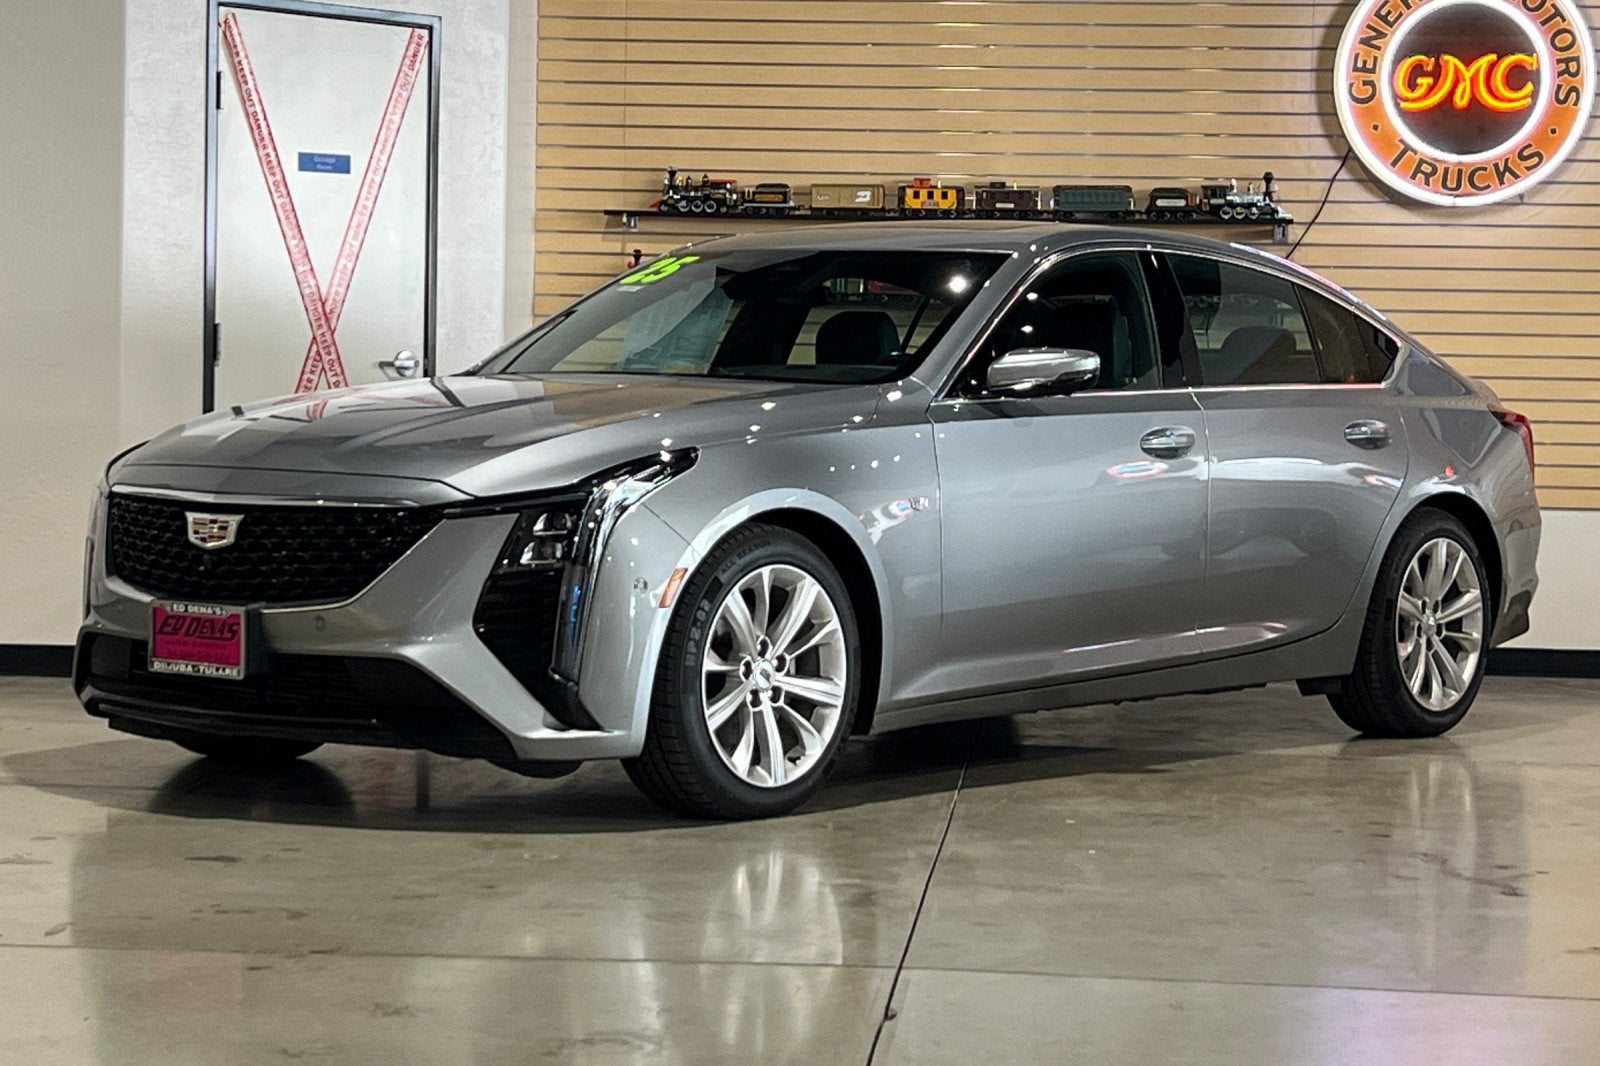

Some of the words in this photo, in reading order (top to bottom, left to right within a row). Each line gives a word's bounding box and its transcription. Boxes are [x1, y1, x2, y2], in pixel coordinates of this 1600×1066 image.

[1393, 53, 1538, 112] GMC
[344, 243, 356, 262] OUT
[372, 157, 384, 176] OUT
[400, 72, 412, 91] OUT
[406, 32, 425, 71] DANGER
[1388, 138, 1544, 191] TRUCKS
[236, 59, 248, 86] KEEP
[244, 87, 255, 108] OUT
[250, 110, 266, 147] DANGER
[263, 151, 277, 177] KEEP
[272, 179, 283, 199] OUT
[317, 331, 331, 357] KEEP
[326, 358, 338, 377] OUT
[173, 603, 185, 613] ED
